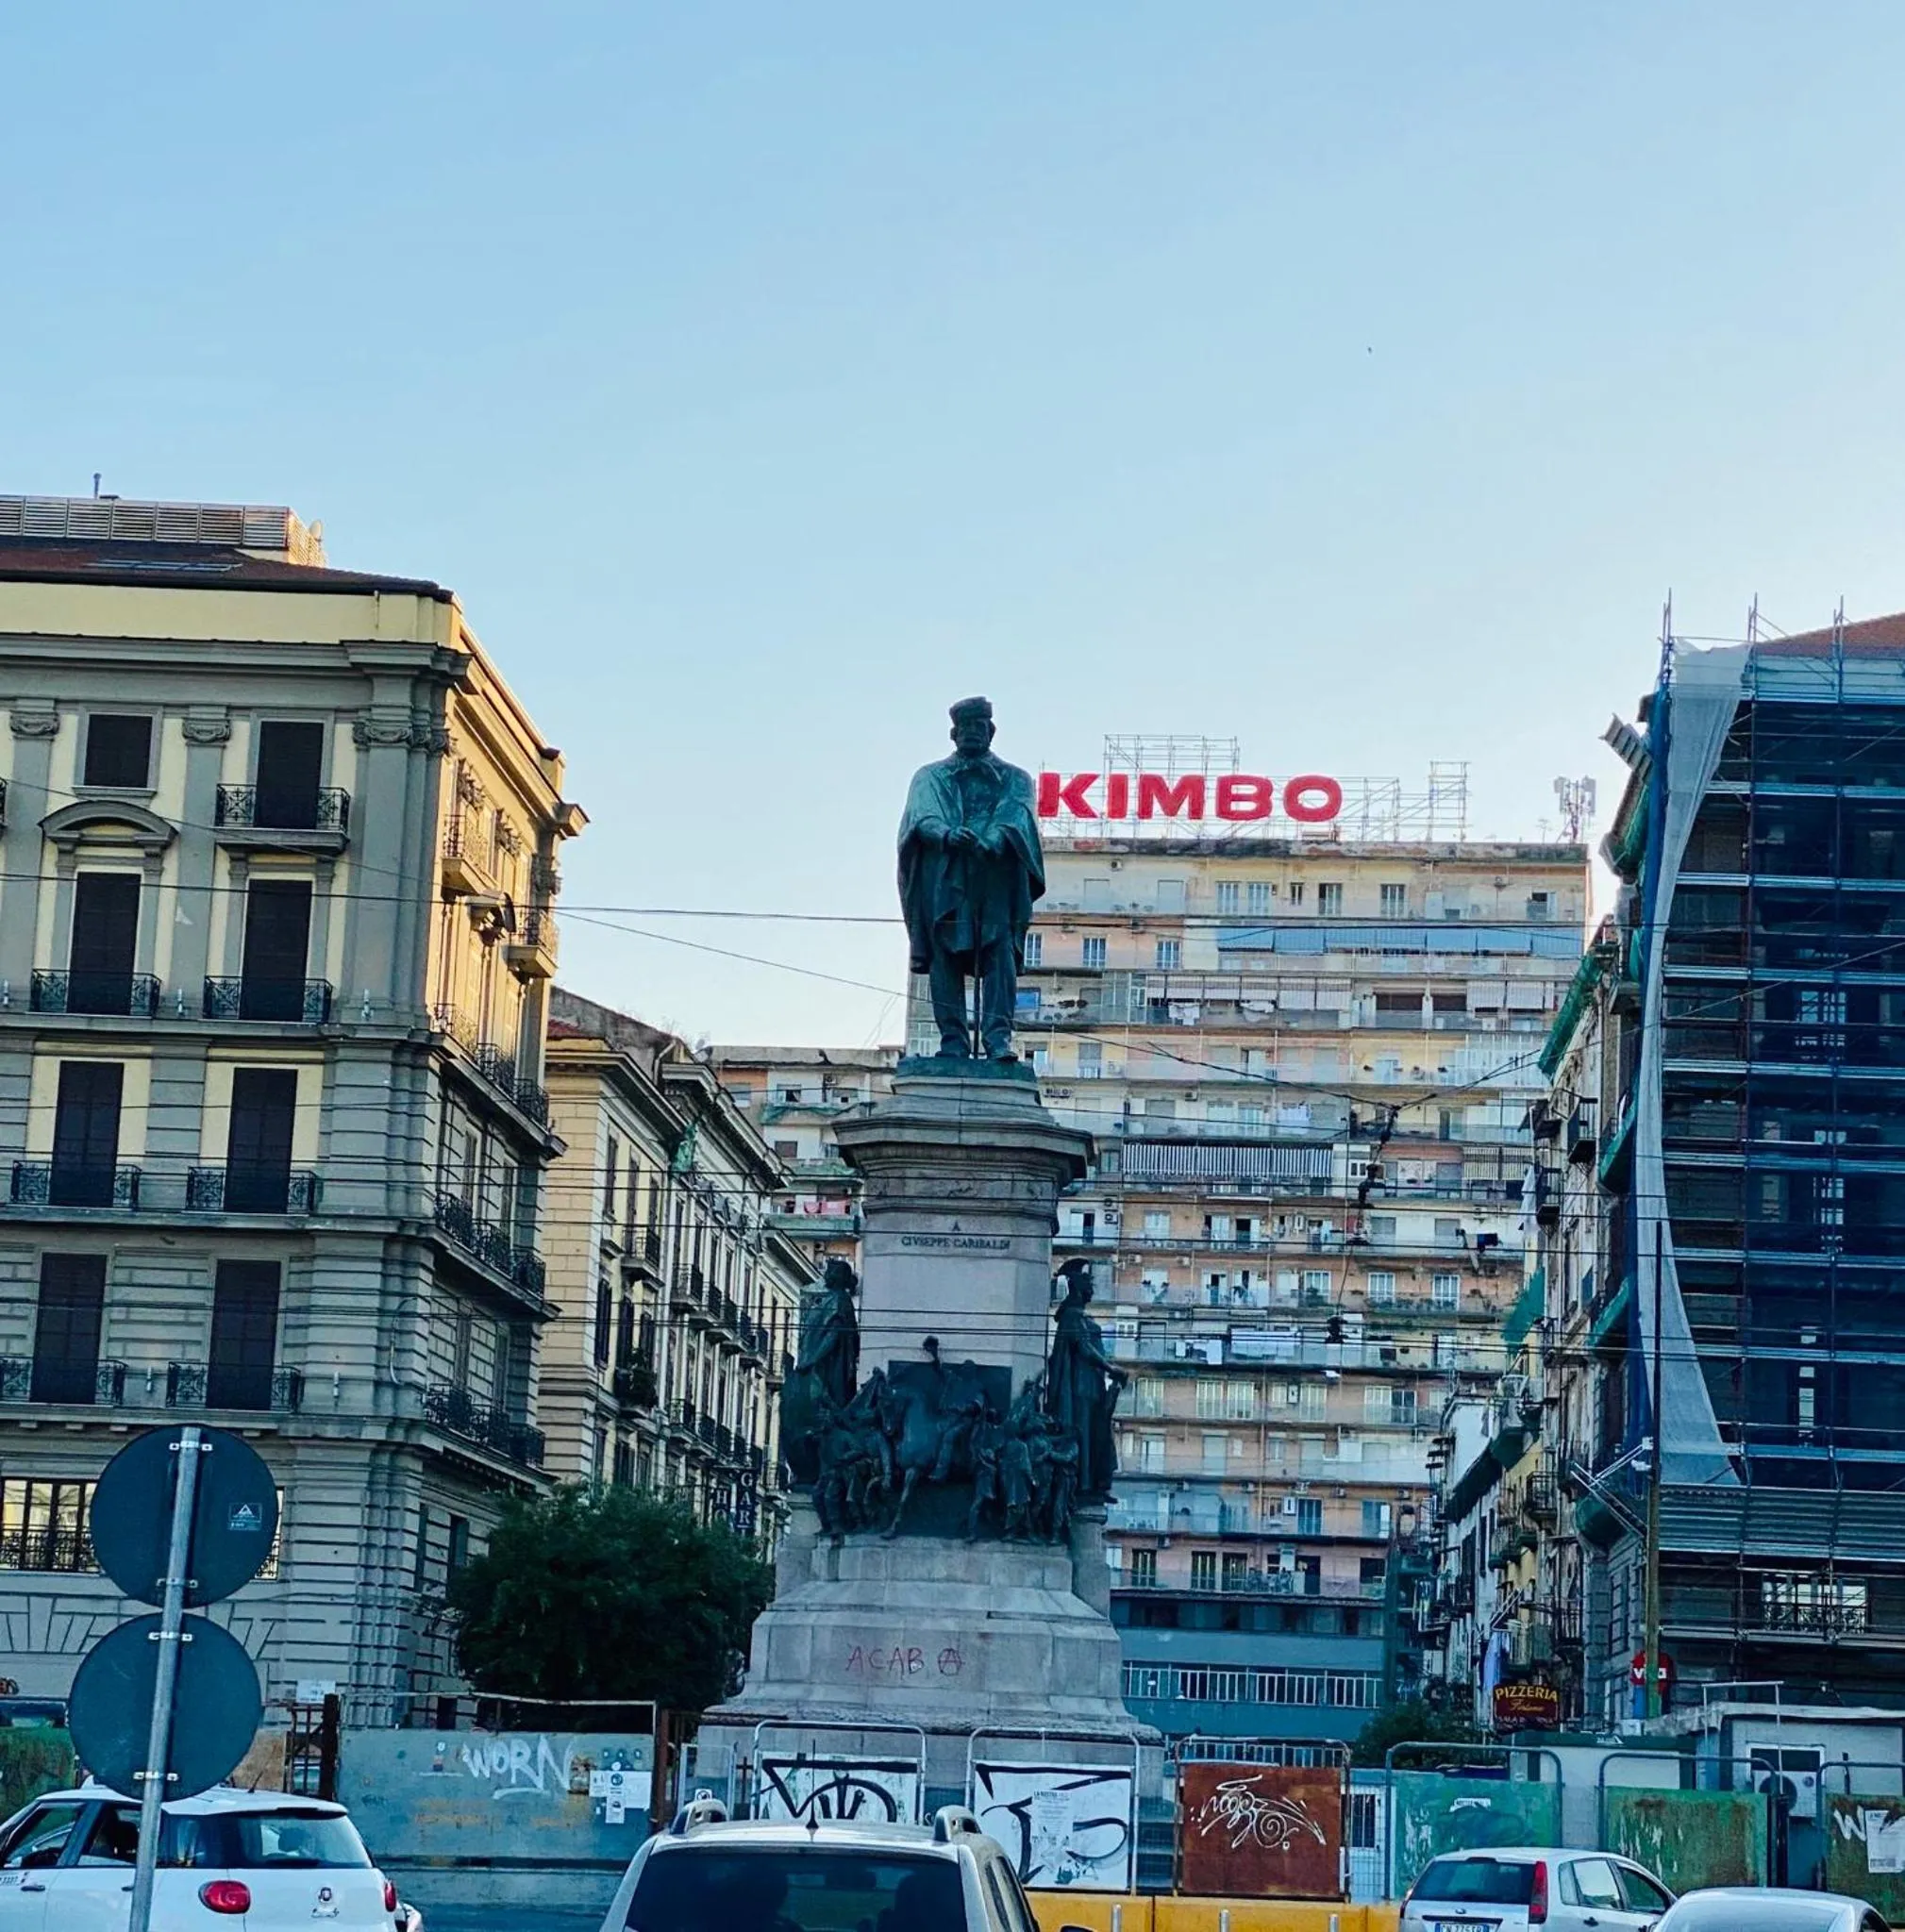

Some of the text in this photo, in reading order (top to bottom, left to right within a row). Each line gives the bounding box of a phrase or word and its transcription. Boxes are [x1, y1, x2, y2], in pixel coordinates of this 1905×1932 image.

[1039, 773, 1342, 822] KIMBO
[952, 1221, 961, 1232] A
[845, 1645, 925, 1680] ACAB
[1495, 1685, 1558, 1702] PIZZERIA
